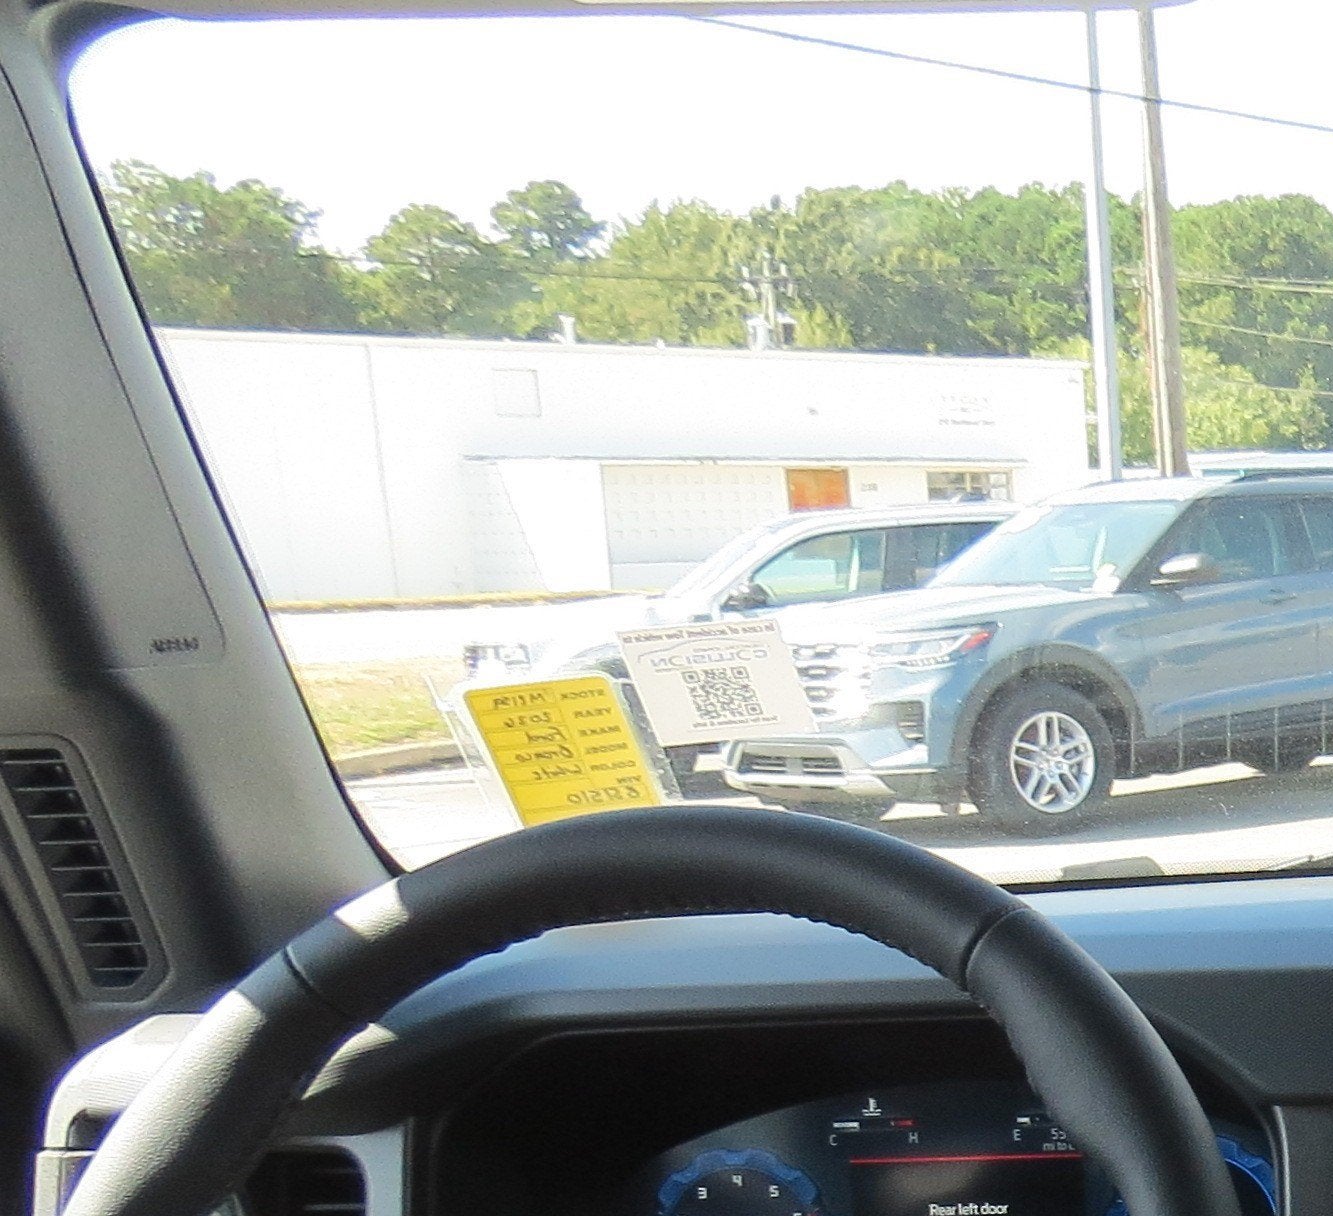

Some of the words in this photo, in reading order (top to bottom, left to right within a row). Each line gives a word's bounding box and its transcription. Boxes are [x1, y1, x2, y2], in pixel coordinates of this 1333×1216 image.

[829, 1135, 838, 1146] C
[908, 1132, 919, 1144] H
[1013, 1130, 1022, 1142] E
[732, 1174, 743, 1187] 4
[697, 1186, 708, 1200] 3
[769, 1185, 780, 1198] 5
[928, 1203, 957, 1216] Rear
[958, 1203, 980, 1216] left
[980, 1202, 1009, 1215] door
